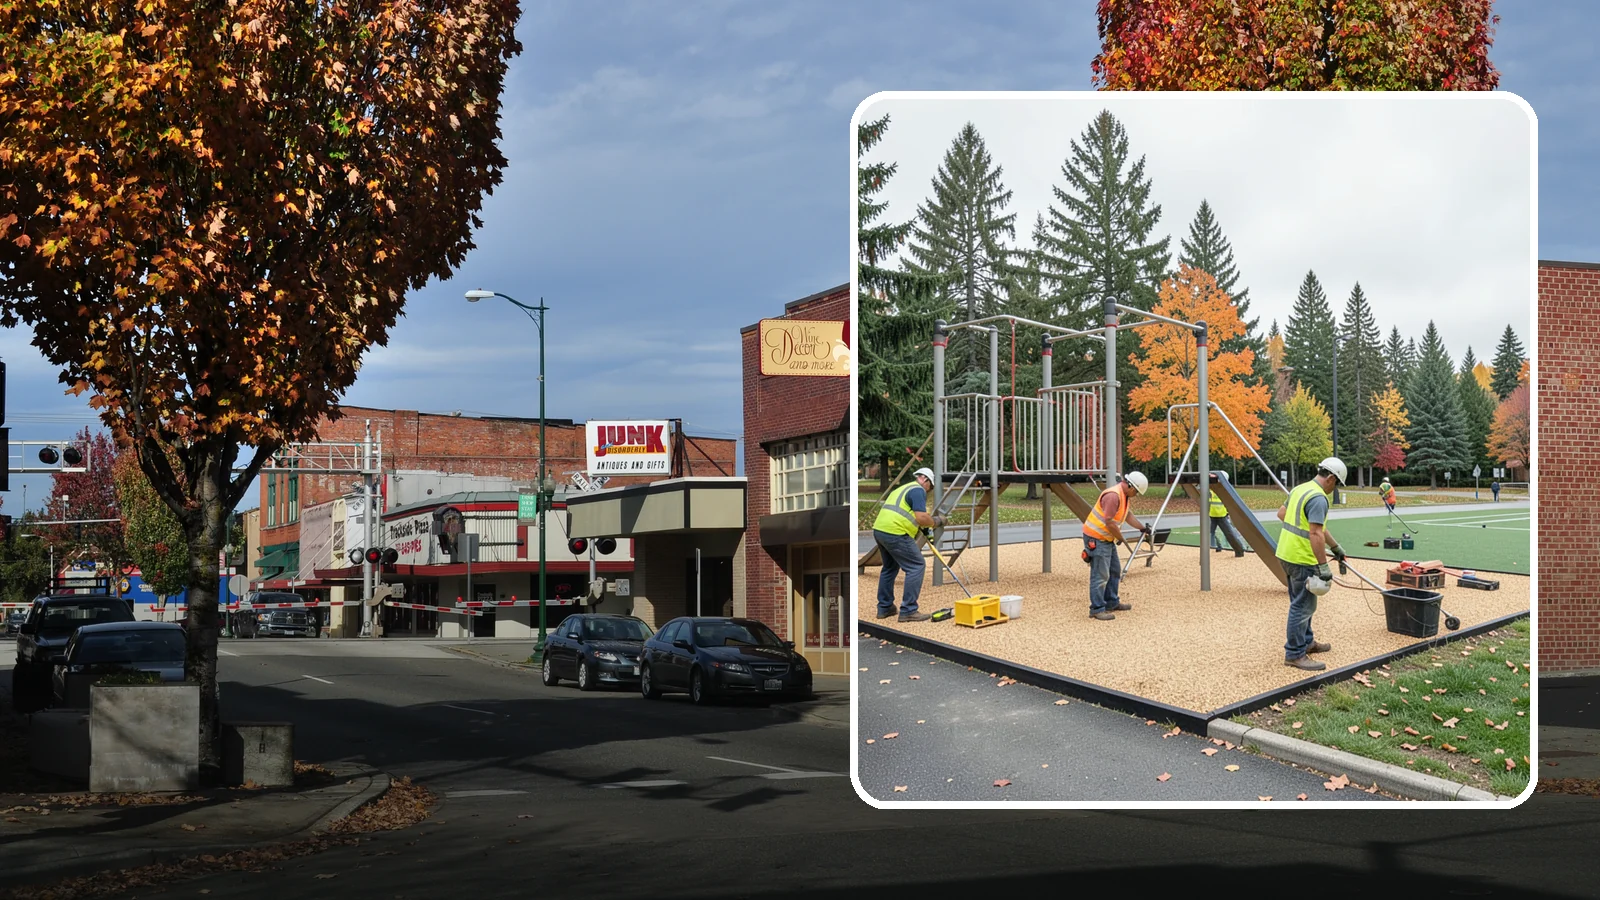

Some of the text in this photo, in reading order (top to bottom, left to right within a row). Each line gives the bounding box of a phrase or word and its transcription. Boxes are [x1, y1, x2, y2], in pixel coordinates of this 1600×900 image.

[595, 425, 665, 457] JUNK
[597, 461, 665, 470] ANTIQUES AND GIFTS
[414, 520, 429, 535] Pizza
